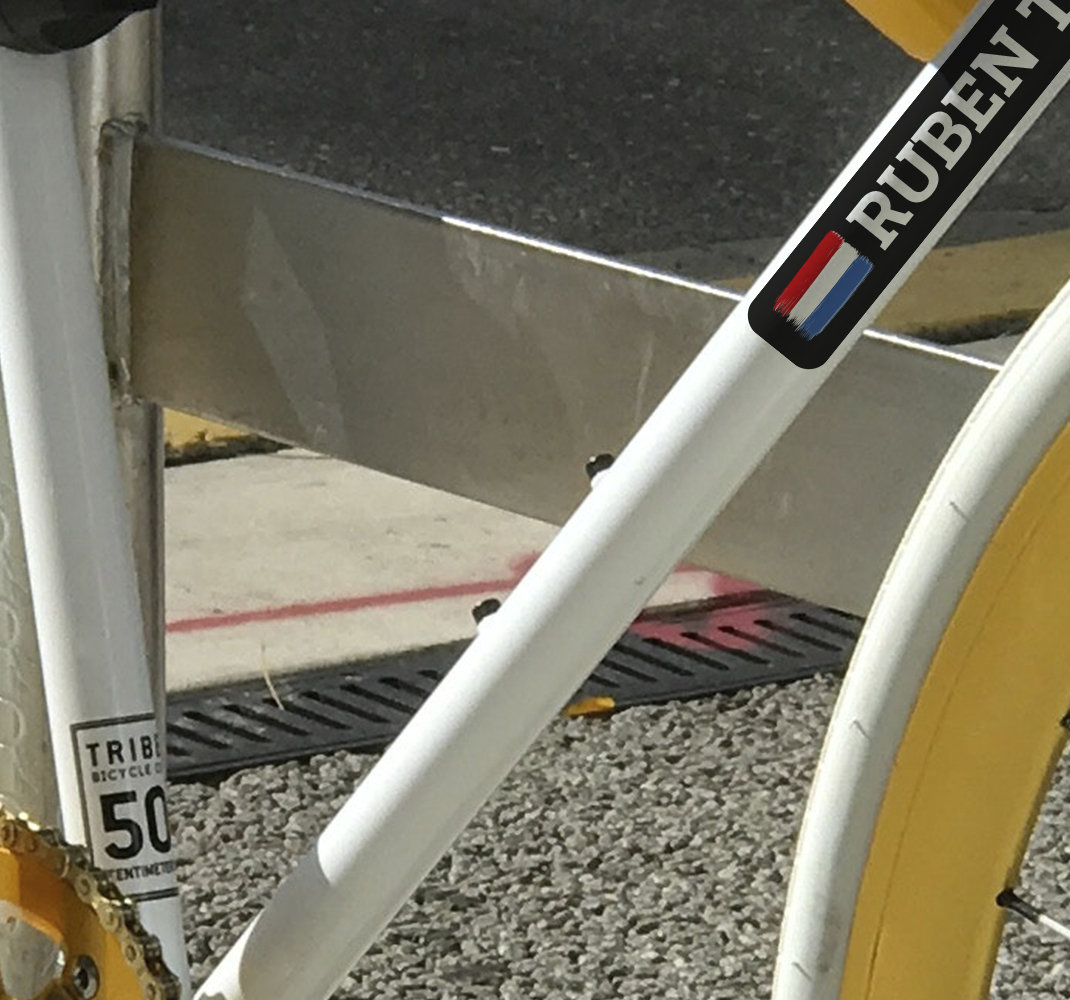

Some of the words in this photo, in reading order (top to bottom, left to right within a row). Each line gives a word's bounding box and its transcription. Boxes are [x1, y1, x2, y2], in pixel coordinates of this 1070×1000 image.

[845, 24, 1040, 251] RUBEN
[92, 763, 152, 783] BICYCLE
[100, 785, 172, 860] 50
